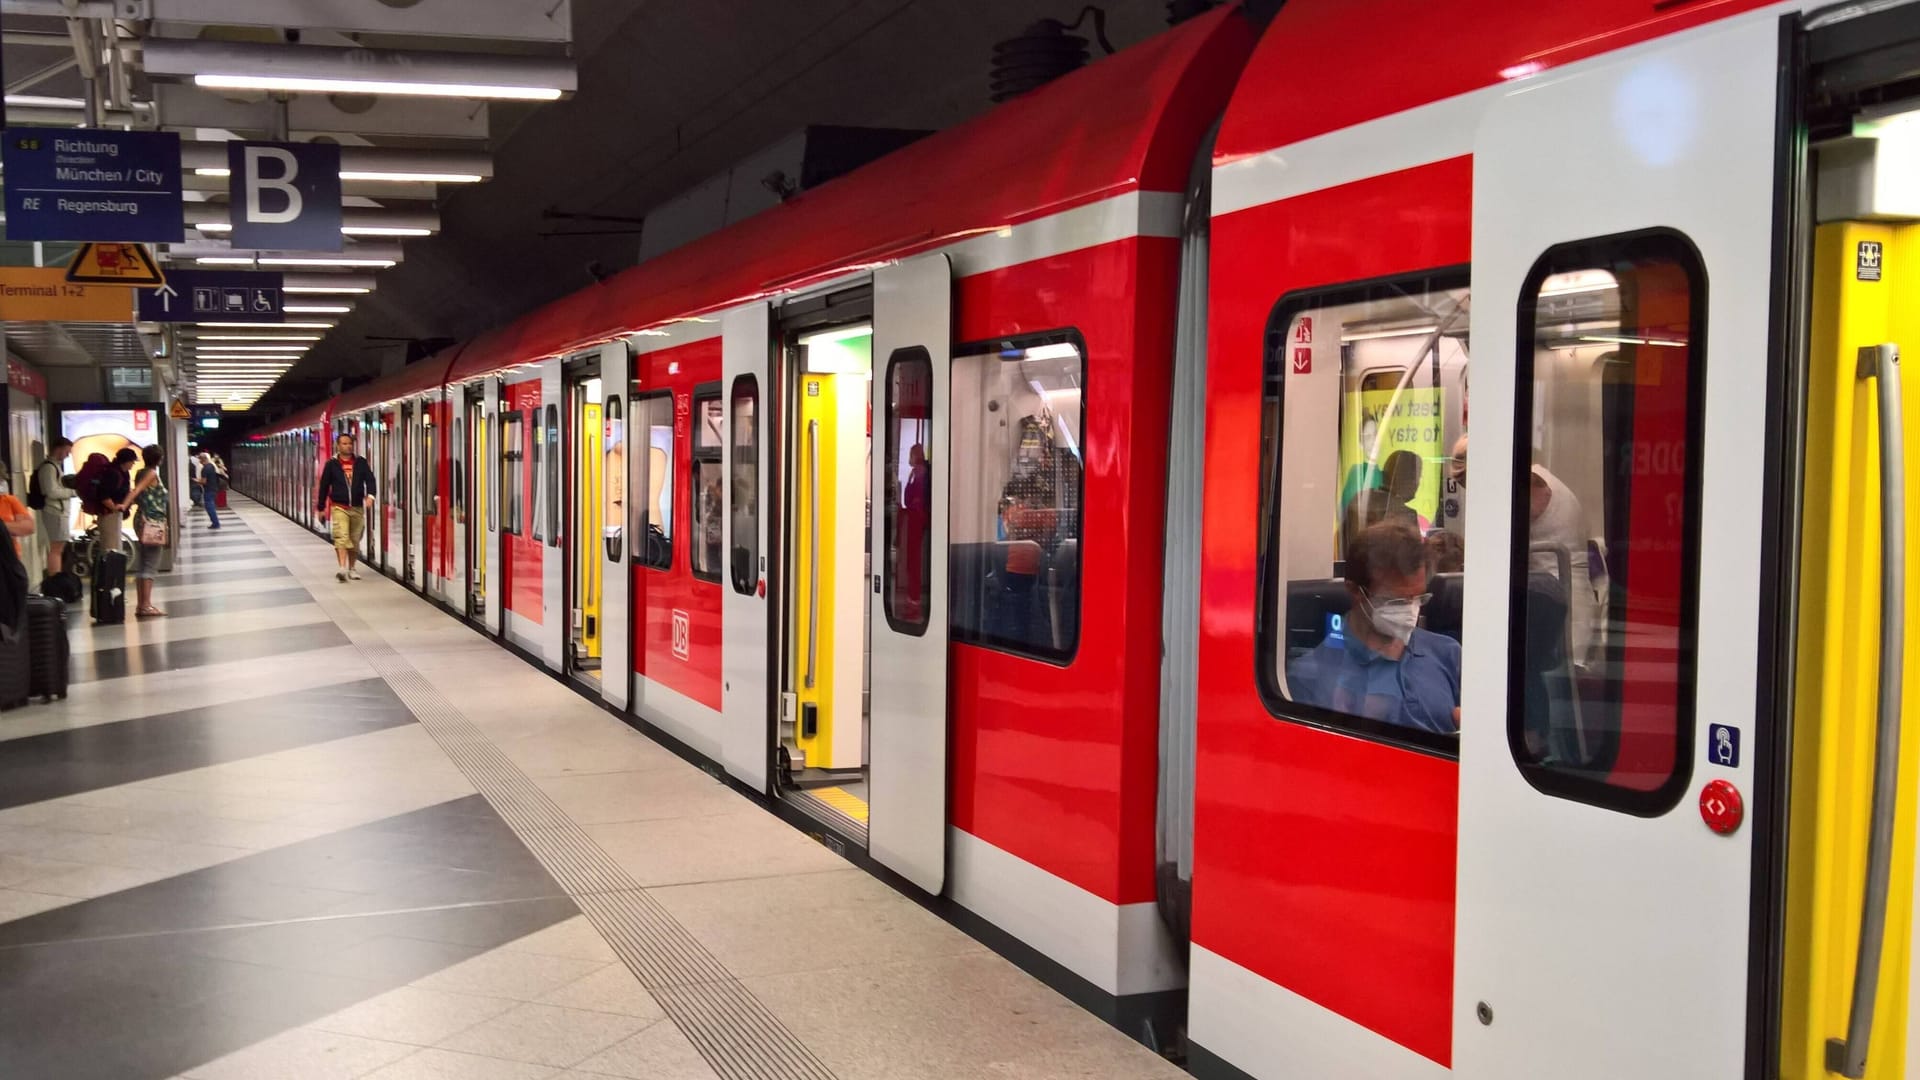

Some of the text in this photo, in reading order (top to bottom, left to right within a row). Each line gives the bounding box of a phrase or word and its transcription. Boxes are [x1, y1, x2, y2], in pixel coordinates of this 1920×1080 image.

[55, 139, 118, 156] Richtung
[56, 168, 122, 182] München
[136, 169, 163, 184] City
[244, 146, 303, 223] B
[23, 198, 138, 215] RE Regensburg
[0, 284, 84, 297] Terminal 1+2
[675, 618, 688, 651] DB
